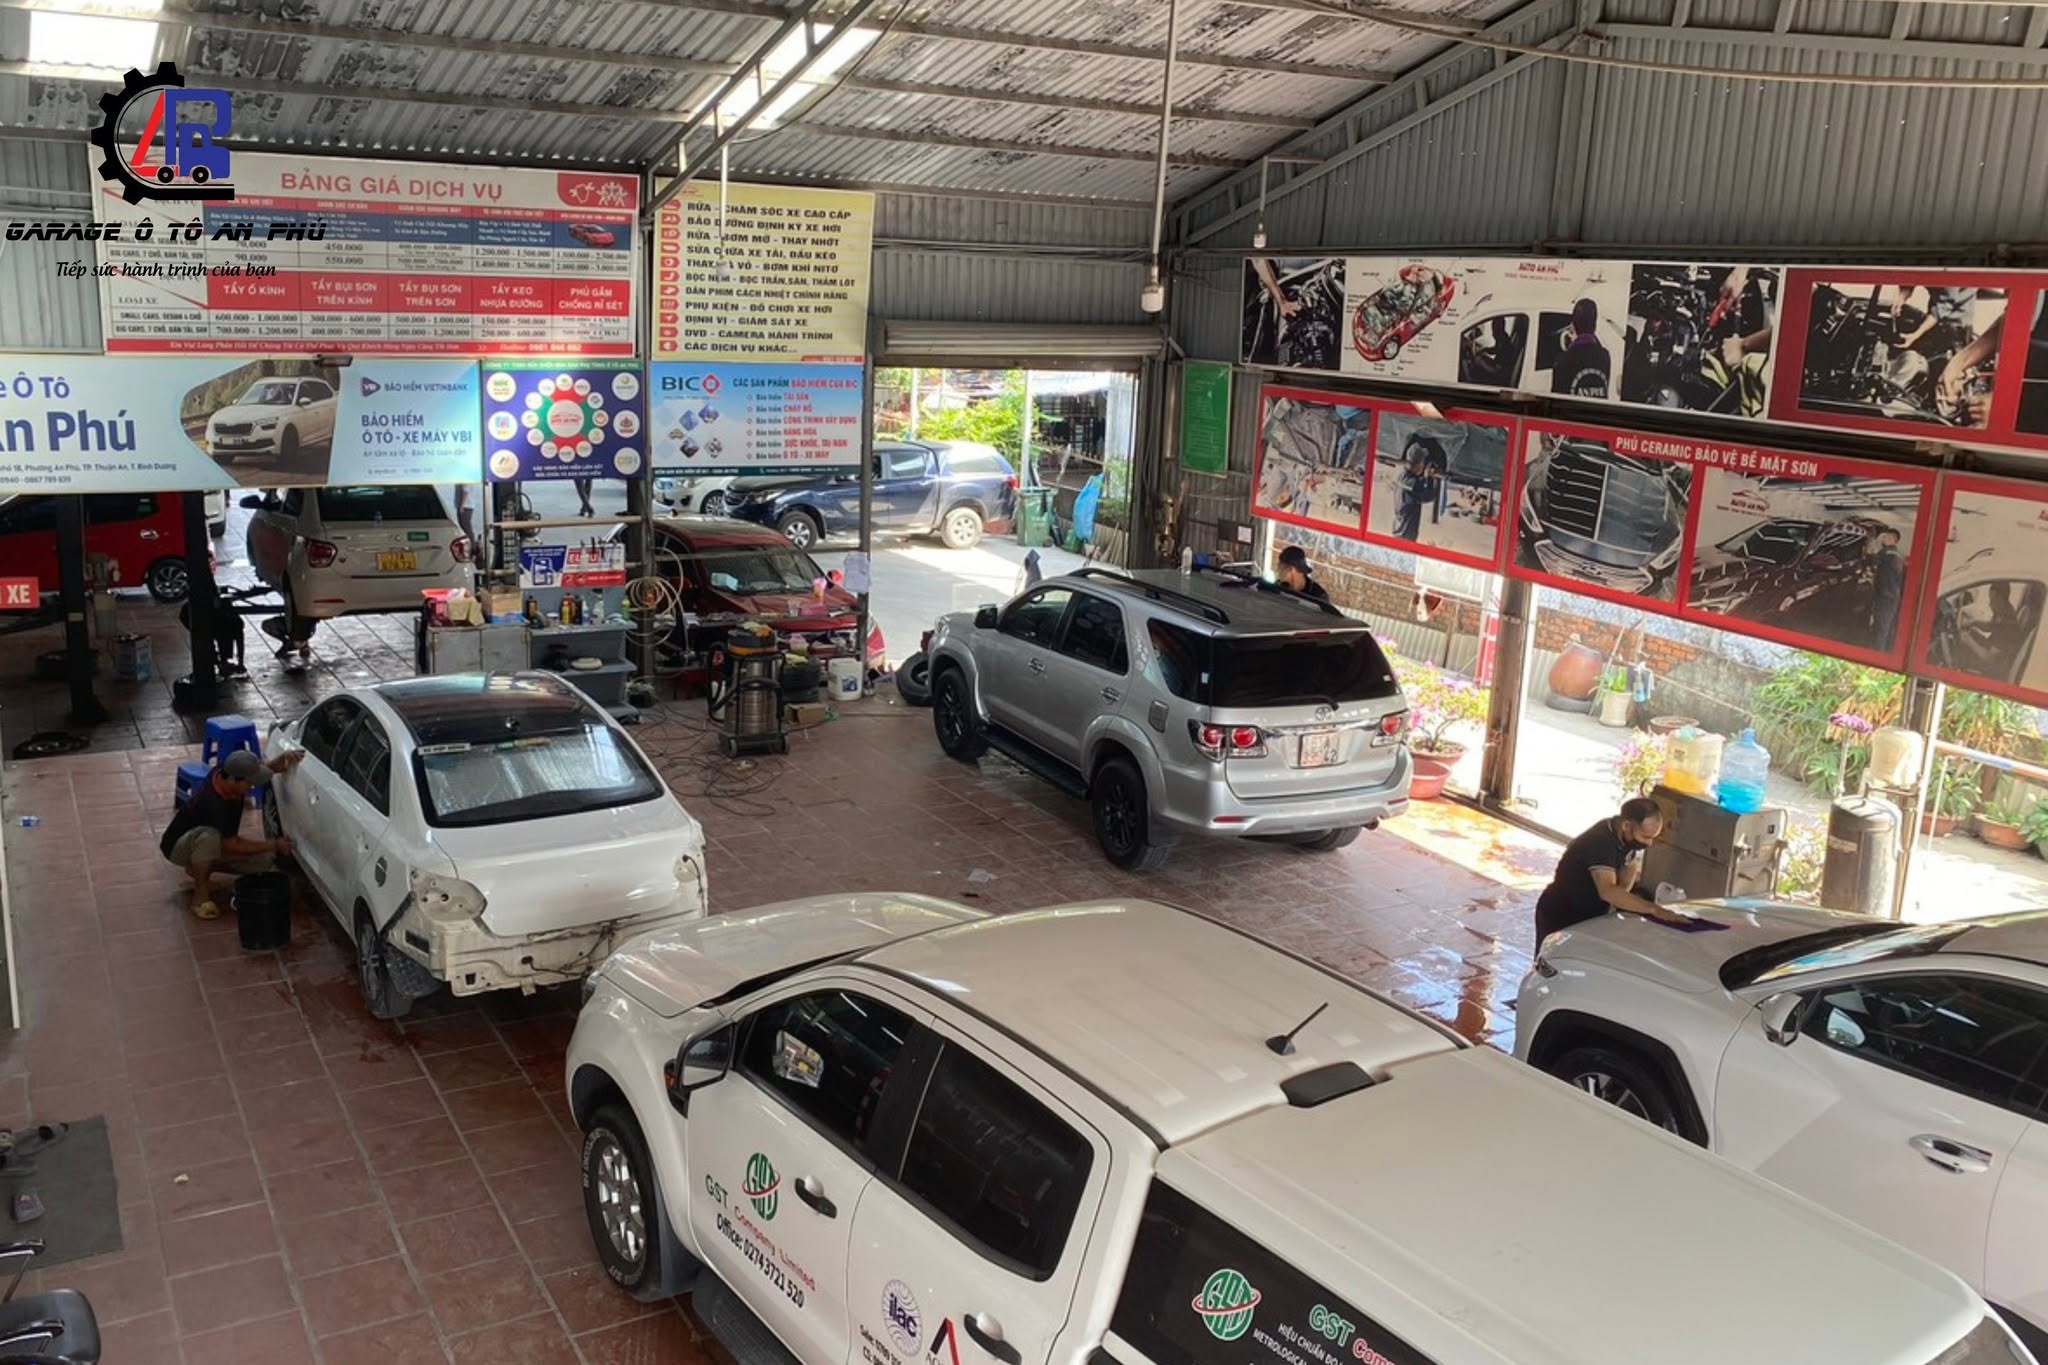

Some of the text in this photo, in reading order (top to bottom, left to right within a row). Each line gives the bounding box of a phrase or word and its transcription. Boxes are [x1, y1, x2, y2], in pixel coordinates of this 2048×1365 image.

[281, 168, 503, 202] BẢNG GIÁ DỊCH VỤ
[761, 206, 783, 216] SÓC
[787, 209, 800, 217] XE
[804, 209, 826, 218] CAO
[829, 209, 851, 219] CẤP
[806, 224, 820, 232] XE
[782, 236, 807, 244] THAY
[748, 248, 762, 257] XE
[797, 305, 810, 313] XE
[719, 330, 765, 338] CAMERA
[13, 372, 34, 398] Ô
[39, 376, 70, 399] Tô
[661, 376, 700, 391] BIC
[361, 410, 424, 426] BẢO HIỂM
[46, 409, 136, 452] Phú
[362, 431, 471, 443] Ô TÔ XE MÁY VBI
[1616, 435, 1818, 477] PHỦ CERAMIC BẢO VỆ BỀ MẶT SƠN
[6, 584, 31, 604] XE
[705, 1174, 816, 1291] GST Company Limited
[717, 1213, 742, 1250] Office:
[787, 1279, 805, 1308] 520
[889, 1292, 917, 1338] ilac
[1309, 1303, 1356, 1347] GST
[1278, 1322, 1299, 1343] HIỆU
[1297, 1336, 1325, 1361] CHUẨN
